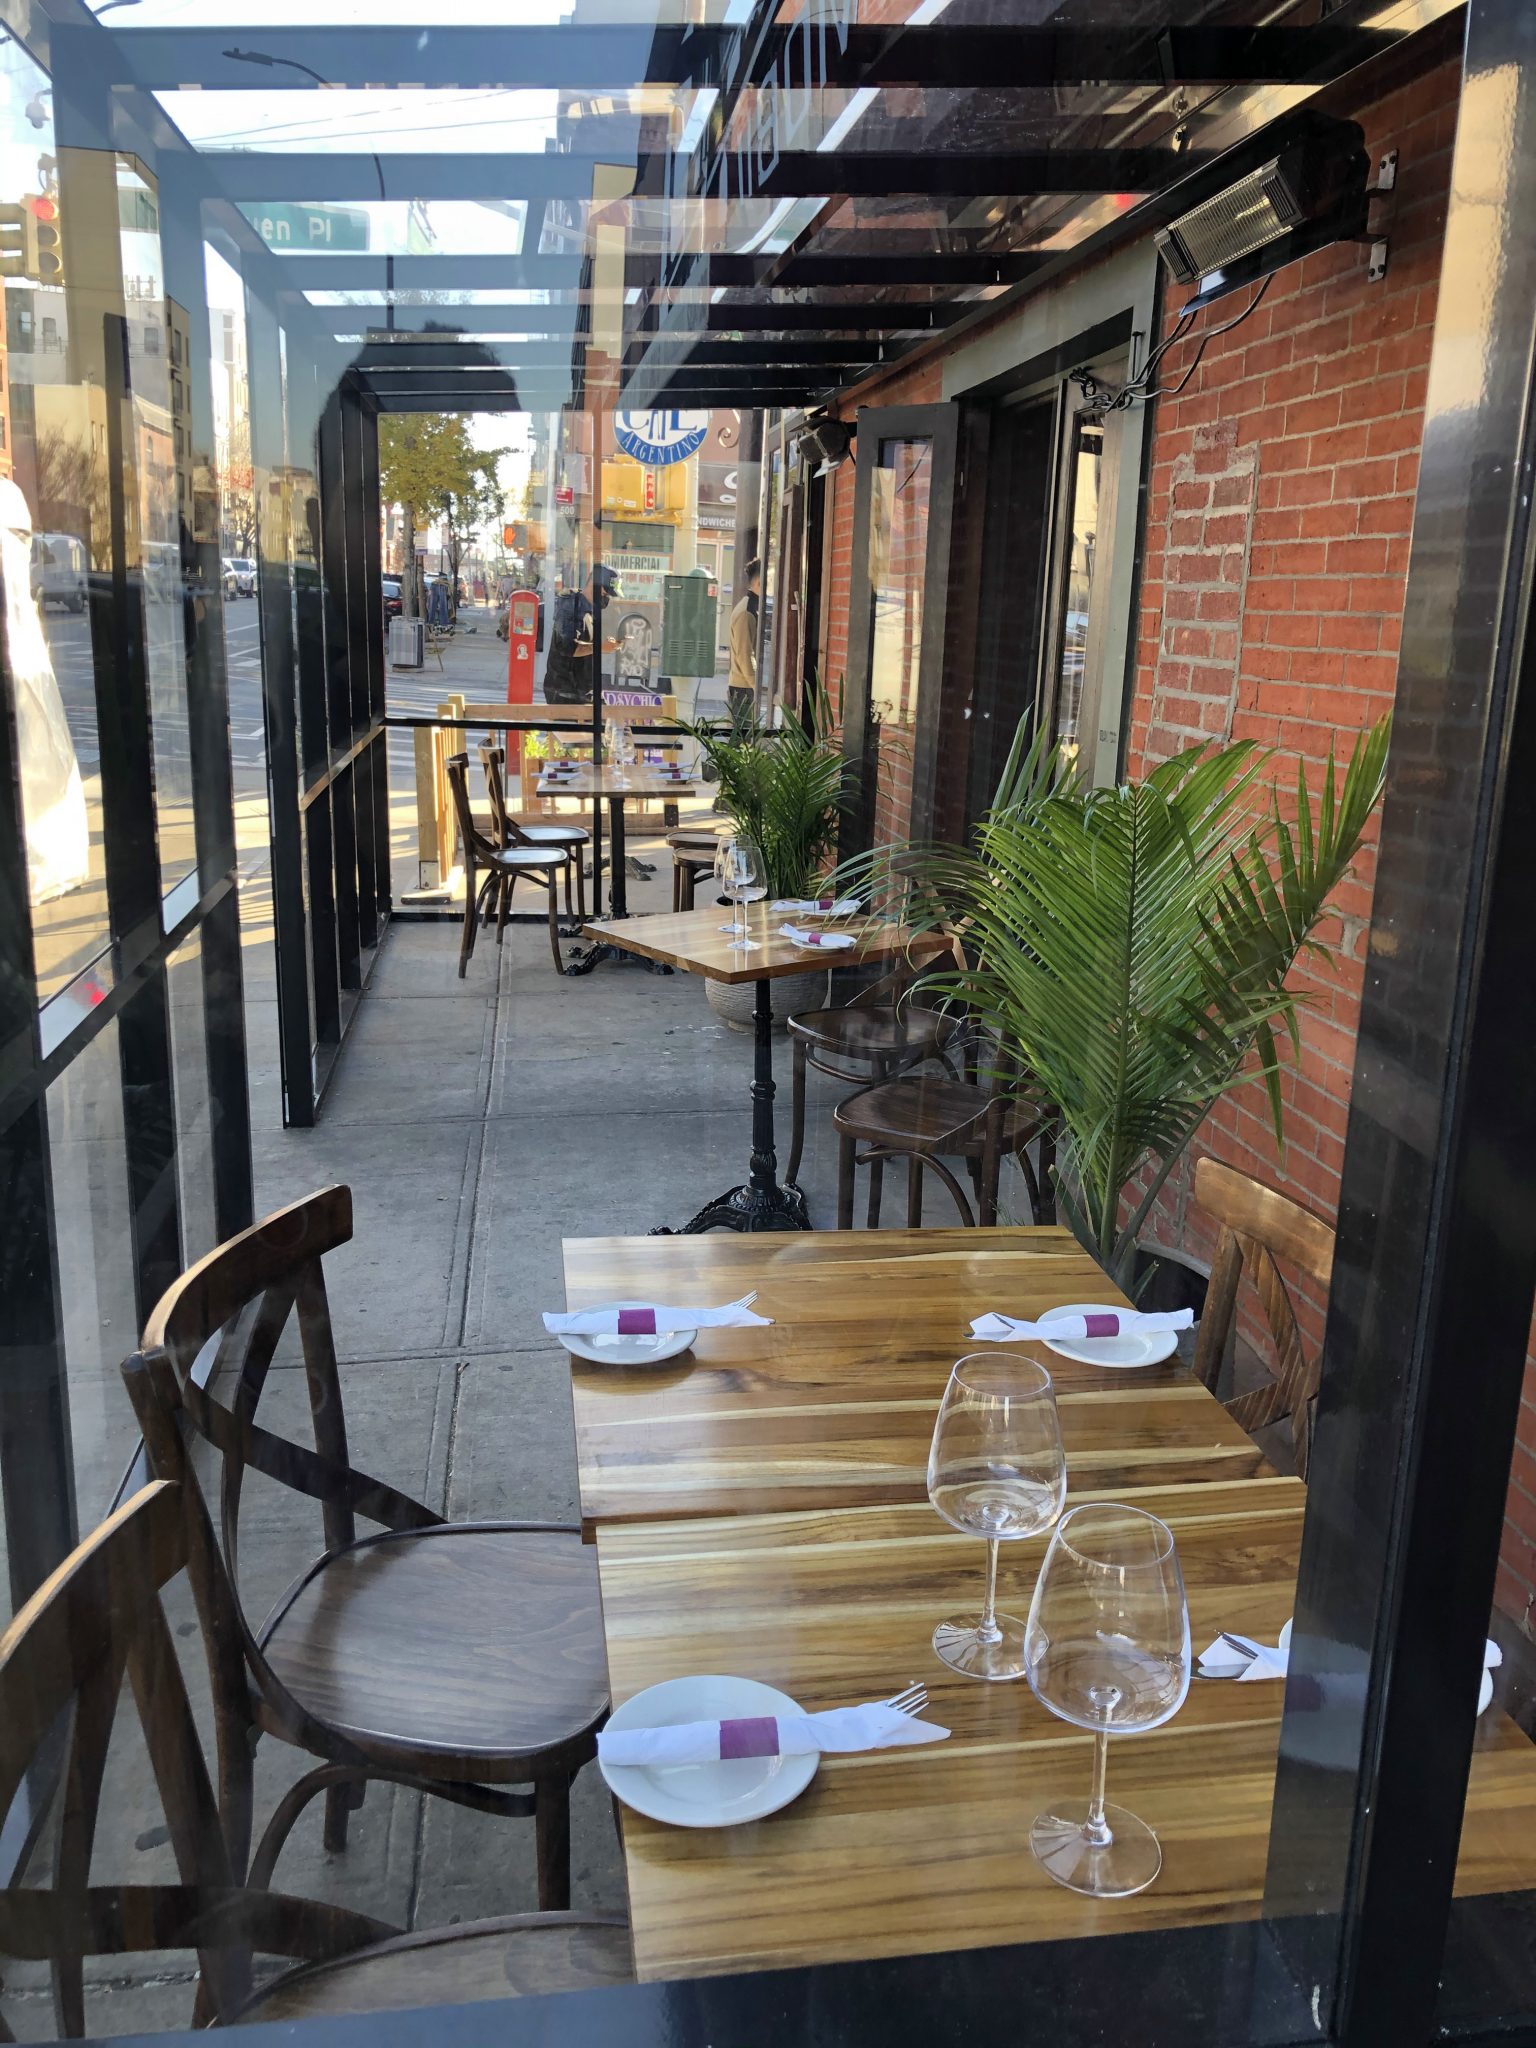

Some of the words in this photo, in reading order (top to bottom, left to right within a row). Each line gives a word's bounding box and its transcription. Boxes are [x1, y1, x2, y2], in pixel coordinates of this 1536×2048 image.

[253, 217, 291, 241] en
[309, 216, 332, 242] Pl
[622, 432, 699, 463] ARGENTINO
[560, 506, 575, 515] 500
[696, 517, 736, 527] NDWICHE
[604, 555, 661, 570] OMMERCIAL
